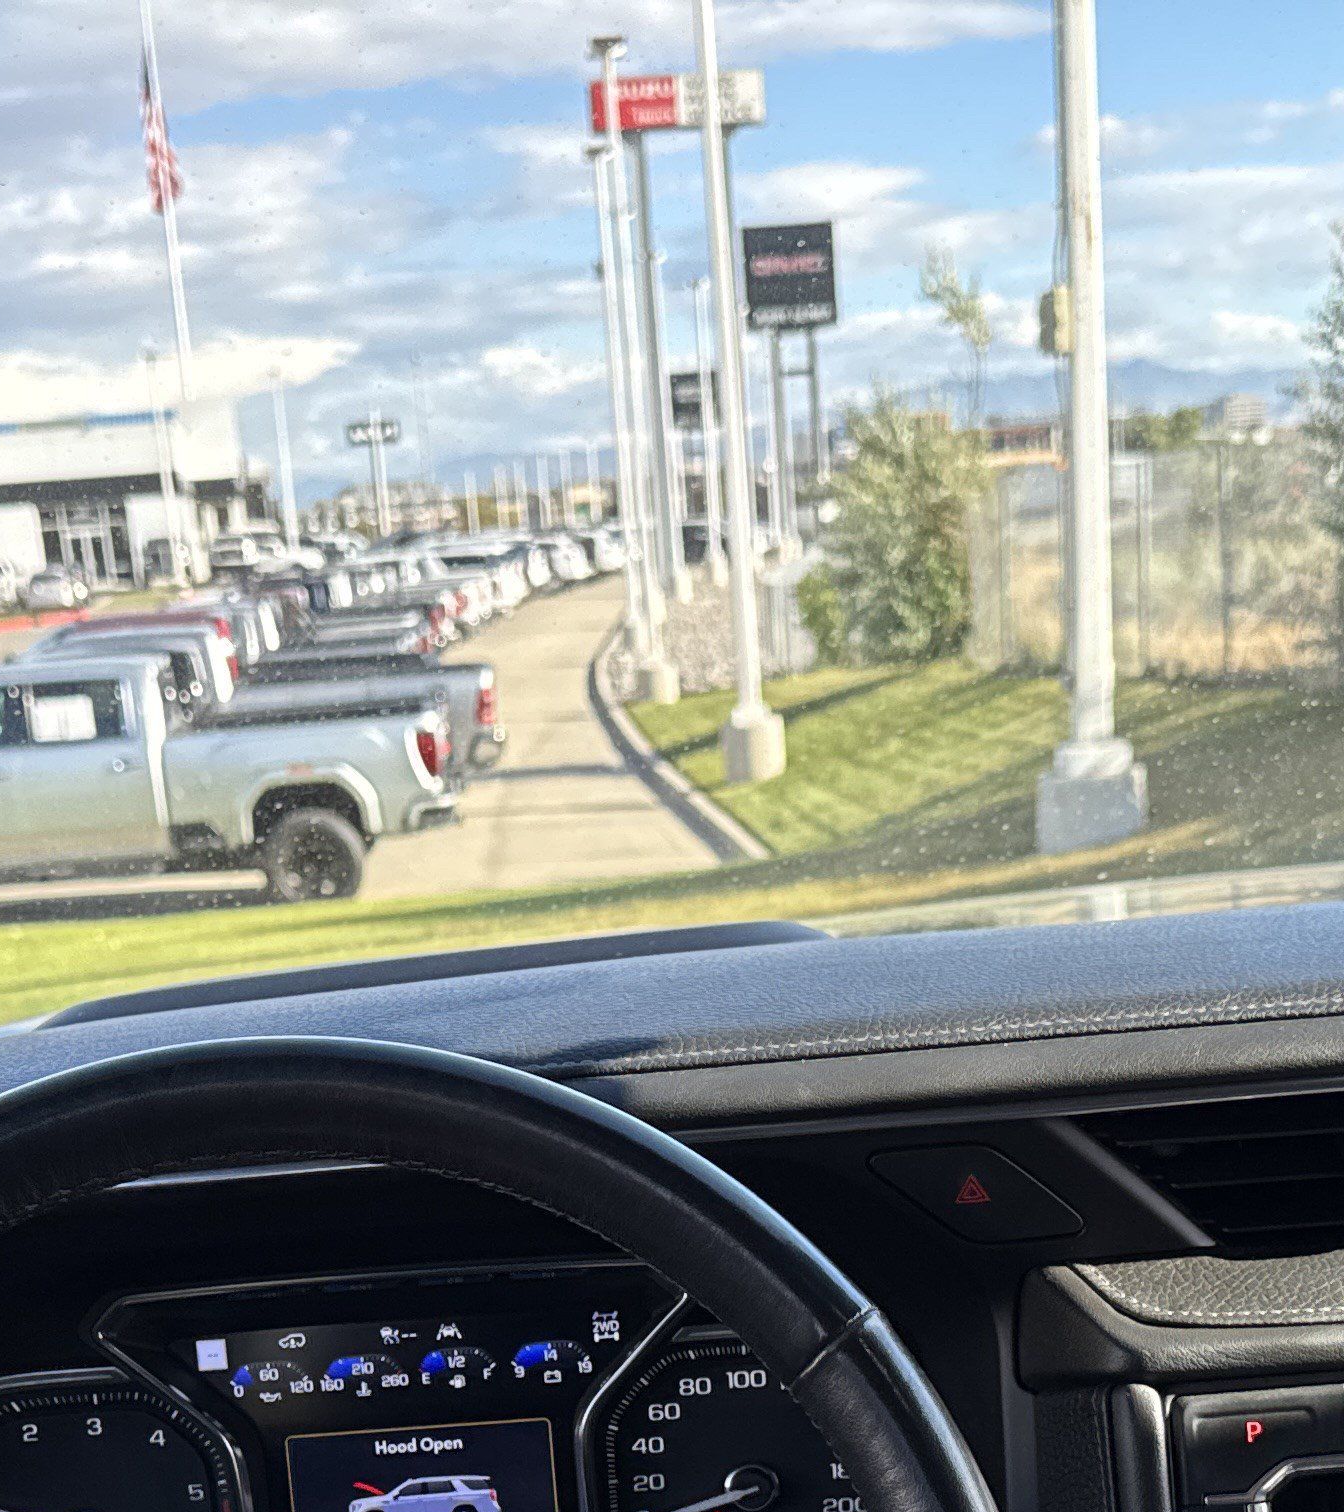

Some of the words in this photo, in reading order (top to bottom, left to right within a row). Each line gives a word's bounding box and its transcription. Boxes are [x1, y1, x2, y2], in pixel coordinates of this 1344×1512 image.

[592, 1320, 620, 1334] 2WD
[543, 1348, 558, 1362] 14
[351, 1361, 374, 1376] 210
[482, 1367, 493, 1380] F
[514, 1365, 526, 1379] 9
[577, 1359, 594, 1374] 19
[259, 1367, 280, 1382] 60
[380, 1373, 410, 1388] 260
[421, 1372, 432, 1385] E
[725, 1369, 768, 1390] 100
[233, 1384, 245, 1399] 0
[289, 1380, 315, 1395] 120
[320, 1377, 345, 1392] 160
[679, 1375, 712, 1398] 80
[648, 1401, 682, 1422] 60
[22, 1423, 40, 1443] 2
[86, 1417, 103, 1437] 3
[1246, 1420, 1263, 1444] P
[149, 1429, 166, 1447] 4
[374, 1437, 417, 1456] Hood
[419, 1434, 464, 1456] Open
[631, 1435, 666, 1456] 40
[633, 1472, 666, 1493] 20
[187, 1483, 205, 1502] 5
